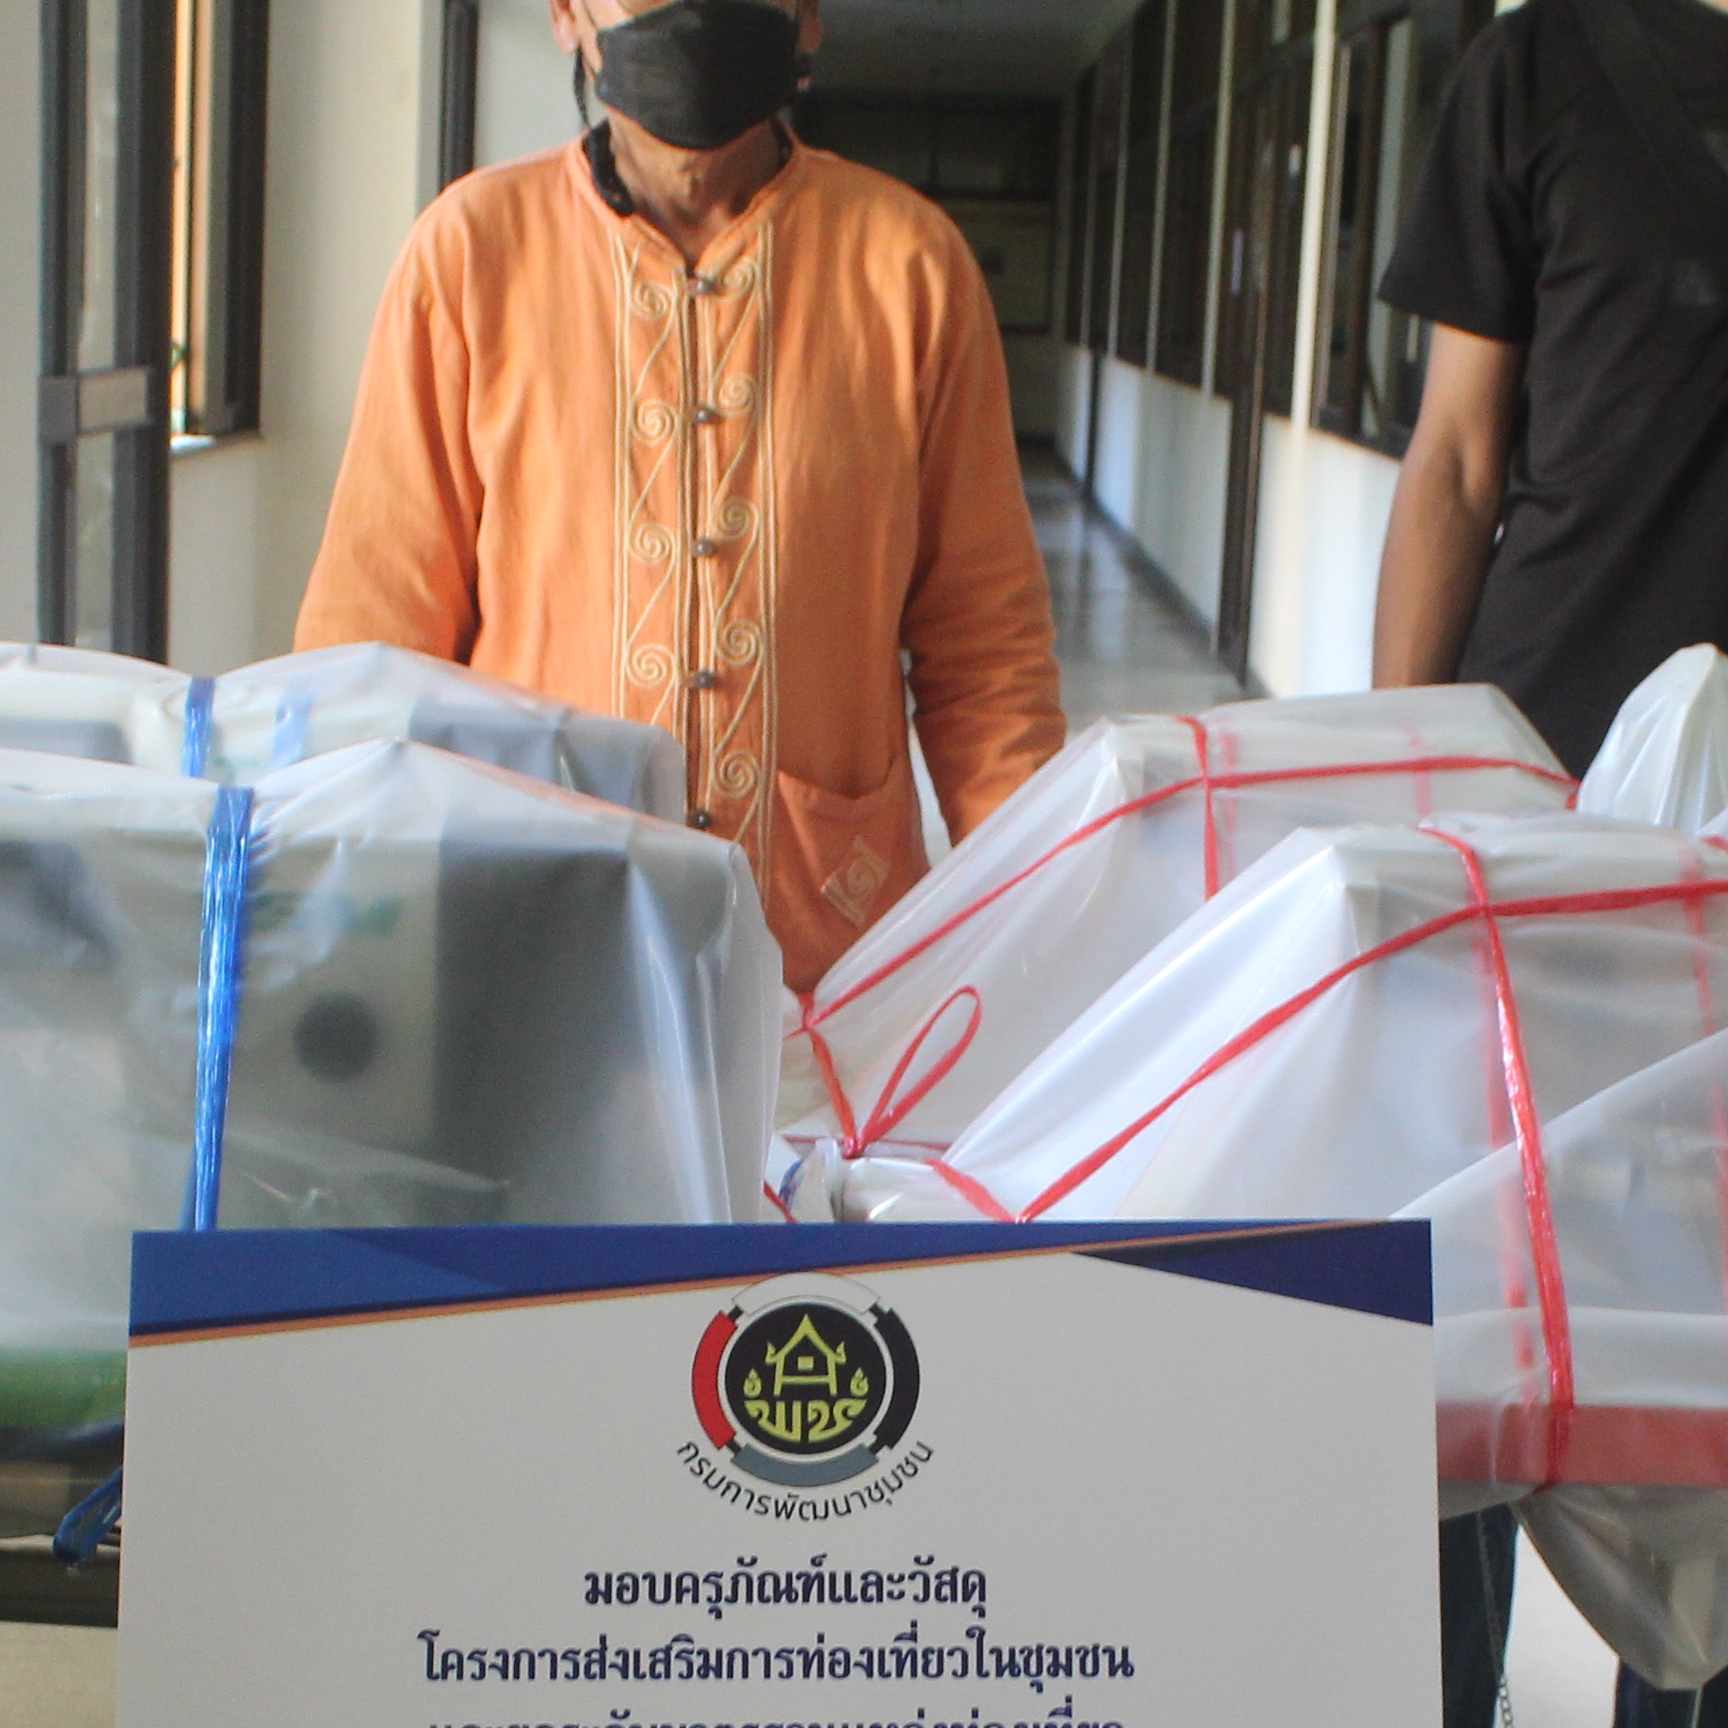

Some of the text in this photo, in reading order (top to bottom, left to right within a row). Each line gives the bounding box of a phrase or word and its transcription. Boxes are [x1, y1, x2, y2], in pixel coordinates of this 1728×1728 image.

[676, 1440, 934, 1521] กรมการพัฒนาชุมชน
[585, 1554, 986, 1619] มอบครุภัณฑ์และวัสดุ
[417, 1621, 1134, 1693] โครงการส่งเสริมการท่องเที่ยวในชุมชน
